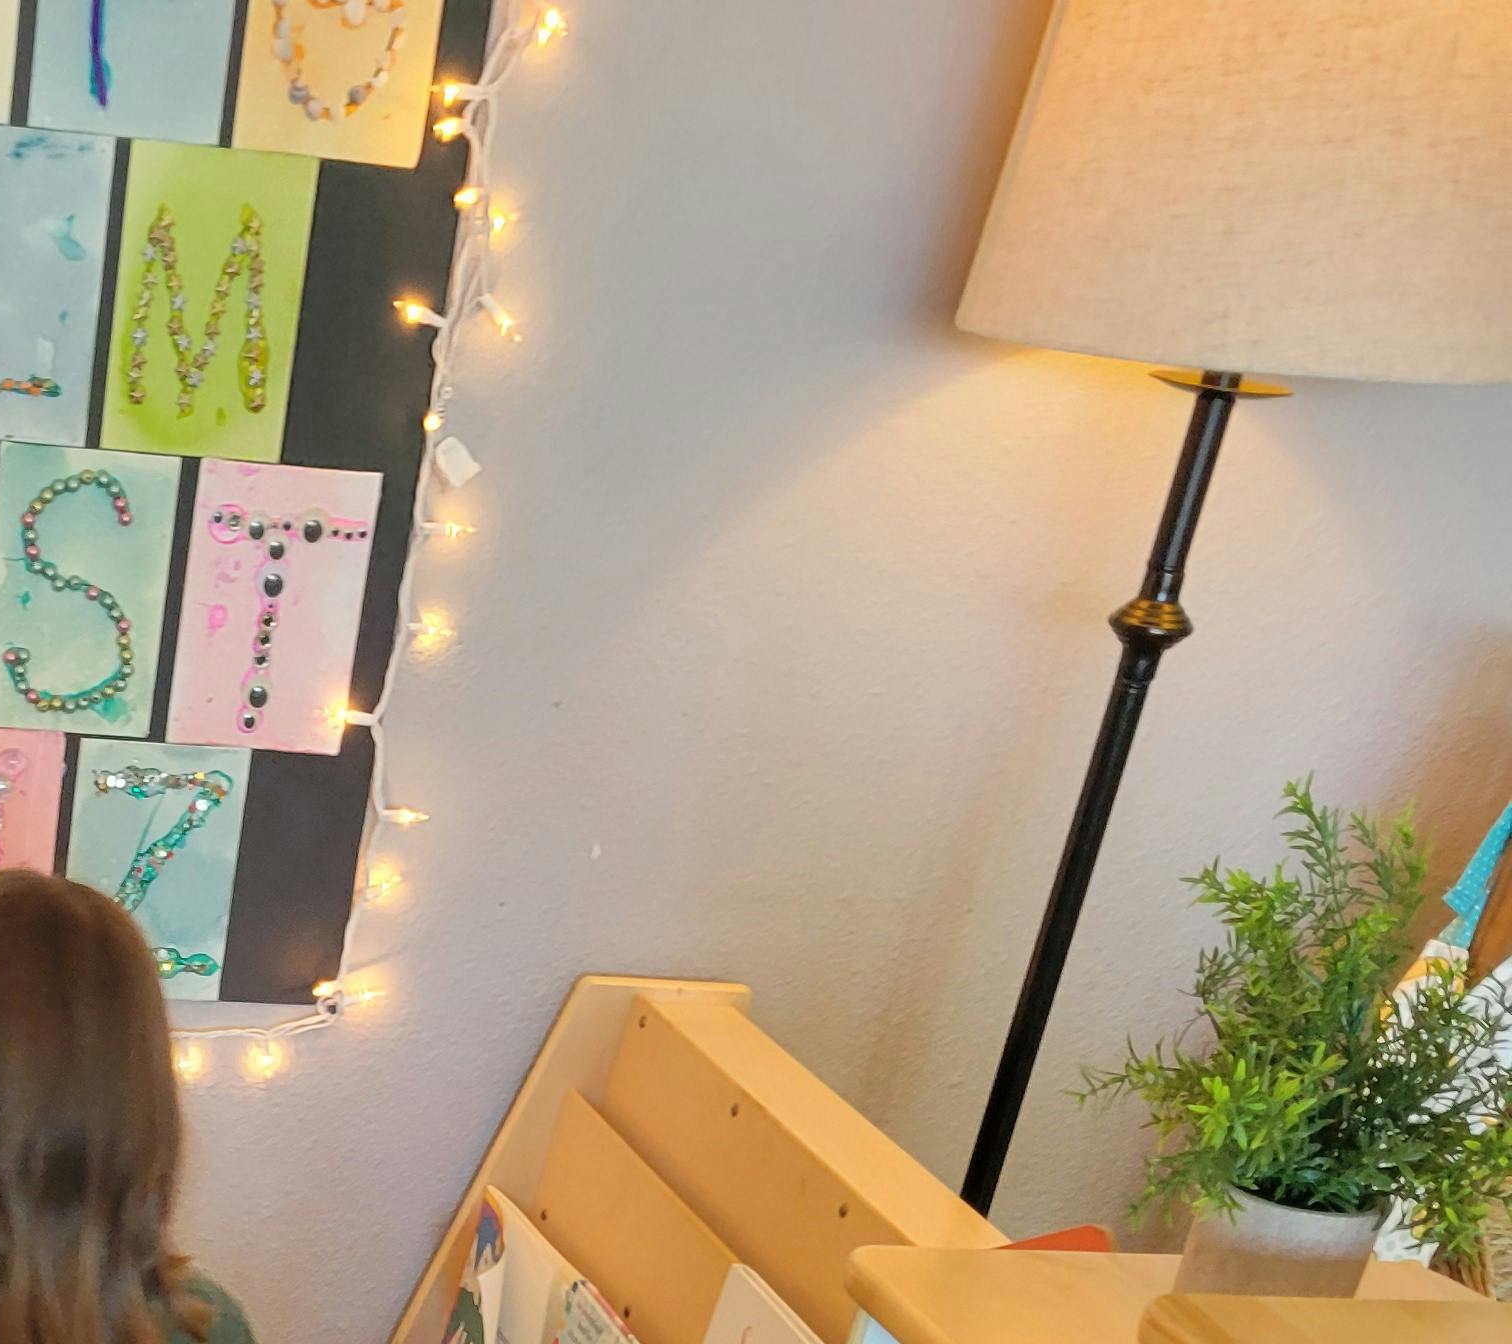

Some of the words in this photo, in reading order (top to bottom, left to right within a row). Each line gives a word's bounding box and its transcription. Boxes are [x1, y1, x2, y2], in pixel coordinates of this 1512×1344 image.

[122, 203, 268, 419] M
[3, 466, 133, 713] S
[210, 502, 369, 734] T
[92, 766, 234, 979] Z
